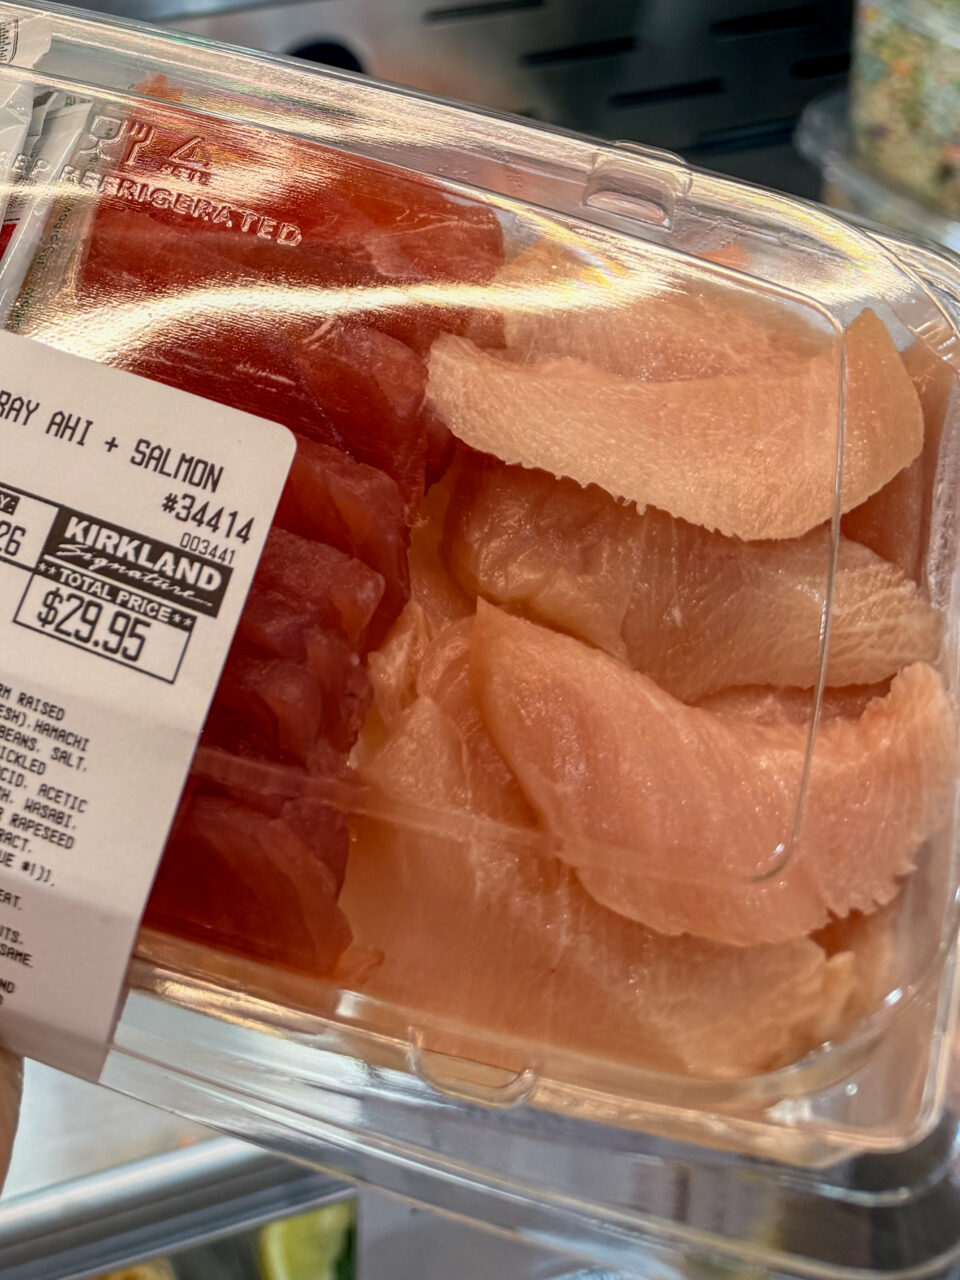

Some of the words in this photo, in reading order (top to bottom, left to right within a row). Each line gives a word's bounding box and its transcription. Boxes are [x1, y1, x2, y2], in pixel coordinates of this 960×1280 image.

[44, 410, 94, 446] AHI
[129, 437, 224, 493] SALMON
[161, 492, 255, 544] #34414
[63, 515, 222, 591] KIRKLAND
[178, 531, 236, 564] 003441
[55, 541, 213, 607] Signature
[36, 586, 152, 662] $29.95
[16, 691, 64, 721] RAISED
[37, 783, 87, 813] ACETIC
[8, 813, 74, 849] RAPESEED
